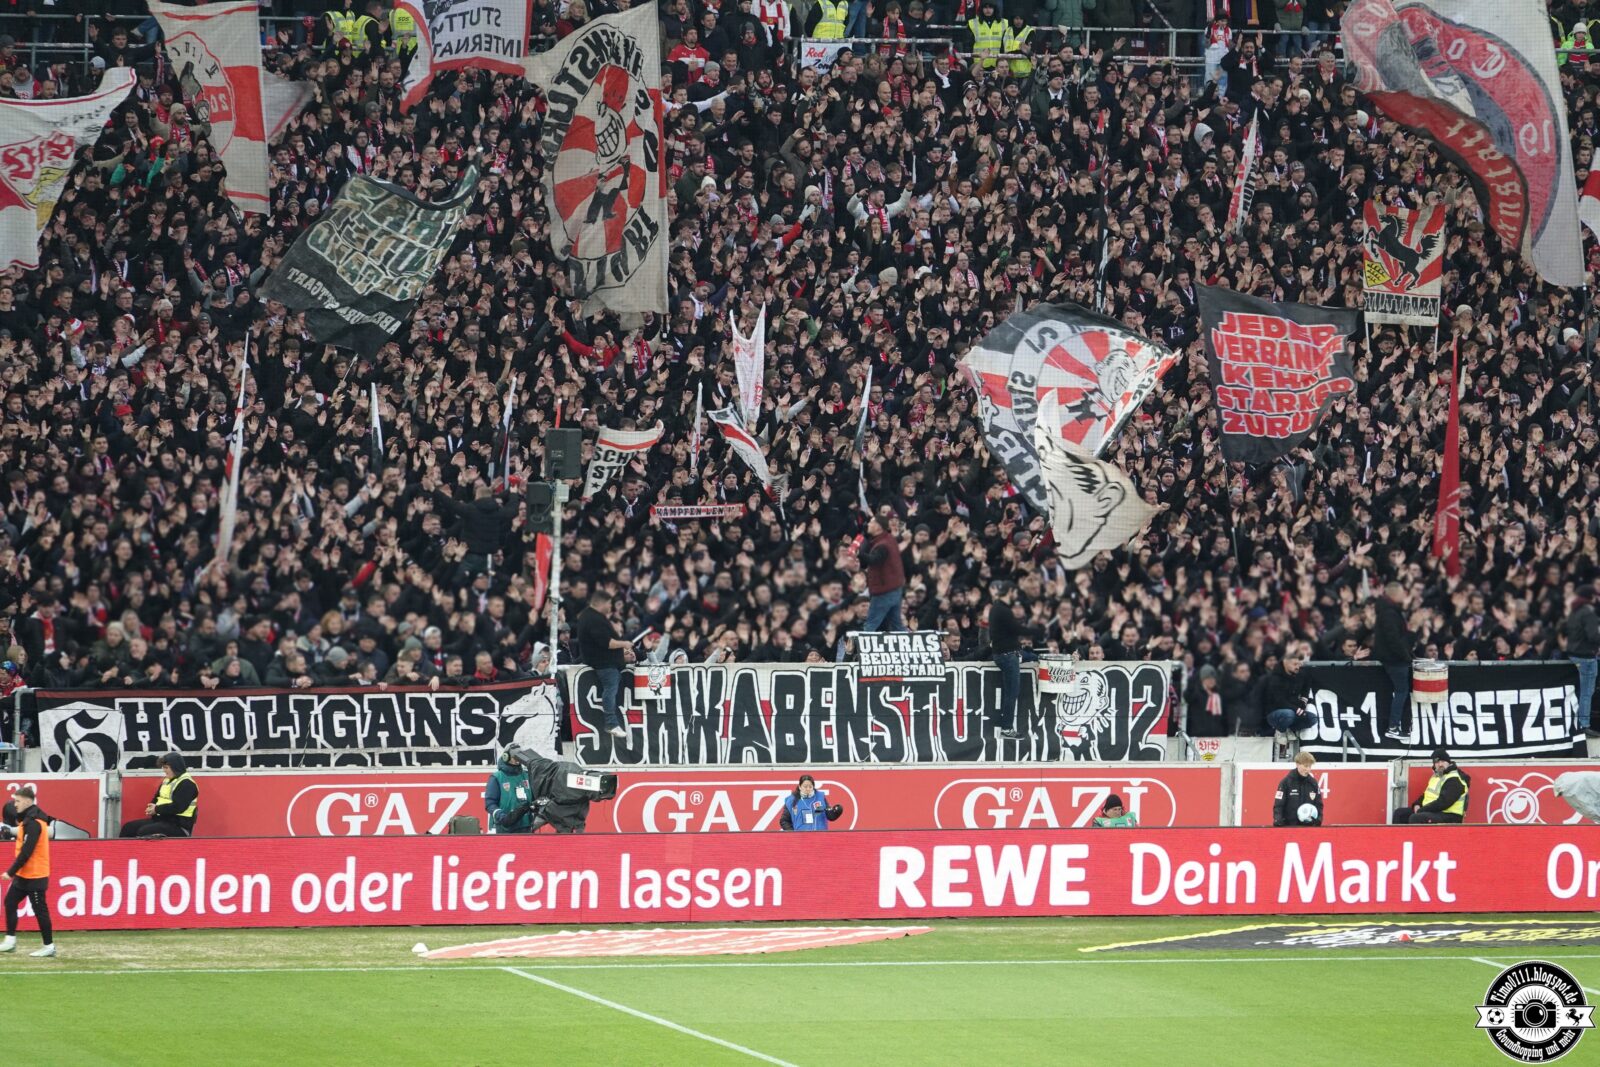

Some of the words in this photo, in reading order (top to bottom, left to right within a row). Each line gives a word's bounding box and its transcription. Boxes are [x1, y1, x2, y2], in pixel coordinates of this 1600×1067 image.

[806, 47, 826, 58] Red
[593, 446, 636, 465] SCH
[592, 465, 619, 480] ST
[857, 634, 941, 653] ULTRAS
[859, 651, 943, 666] BEDEUTET
[860, 664, 947, 677] WIDERSTAND
[115, 693, 501, 753] HOOLIGANS
[573, 664, 1063, 766] SCHWABENSTURM
[1100, 664, 1168, 763] 02
[57, 858, 271, 917] abholen
[291, 856, 413, 913] oder
[432, 853, 599, 911] liefern
[620, 853, 783, 909] lassen
[878, 843, 1090, 908] REWE
[1129, 842, 1256, 906] Dein
[1278, 841, 1457, 904] Markt
